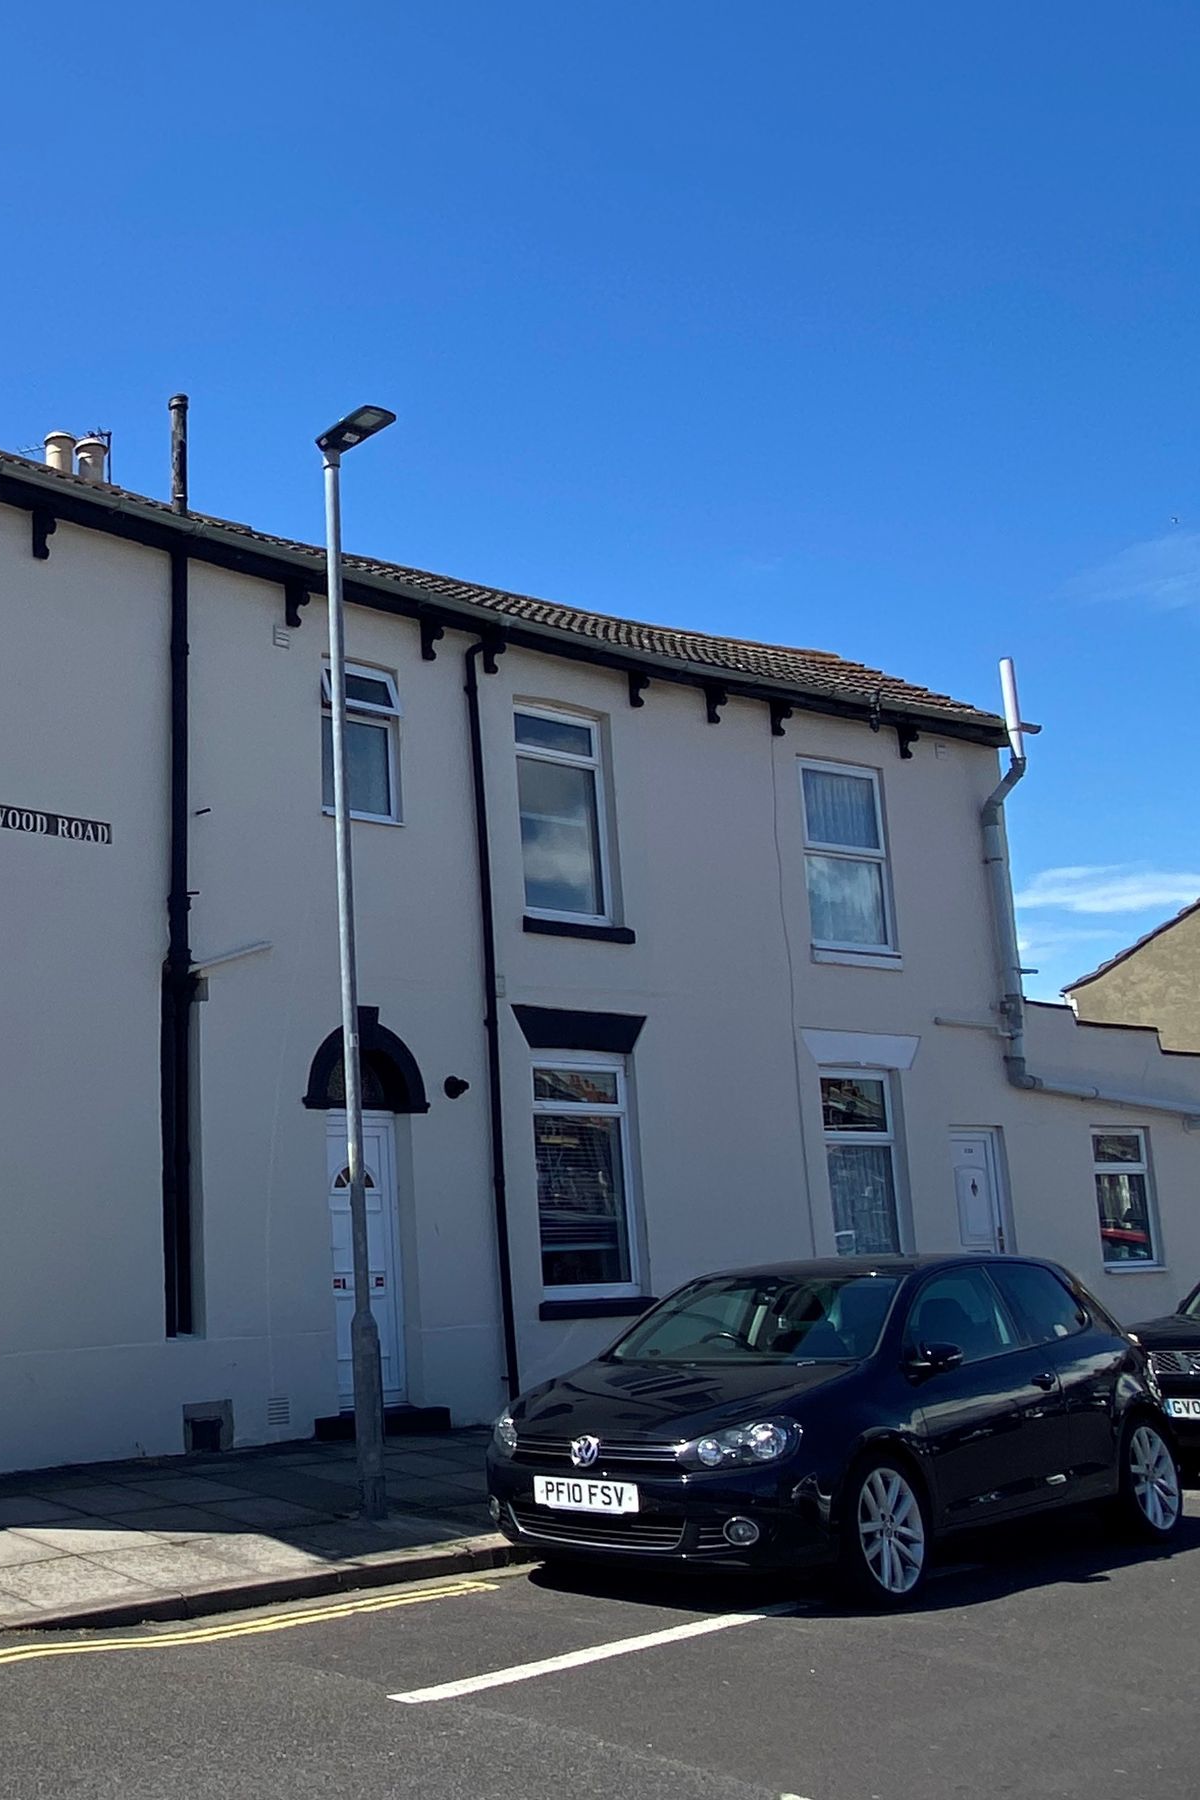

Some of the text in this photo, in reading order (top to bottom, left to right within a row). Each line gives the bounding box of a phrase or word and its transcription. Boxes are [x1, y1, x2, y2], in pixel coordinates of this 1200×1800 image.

[57, 817, 109, 844] ROAD
[545, 1481, 624, 1507] PF10 FSV
